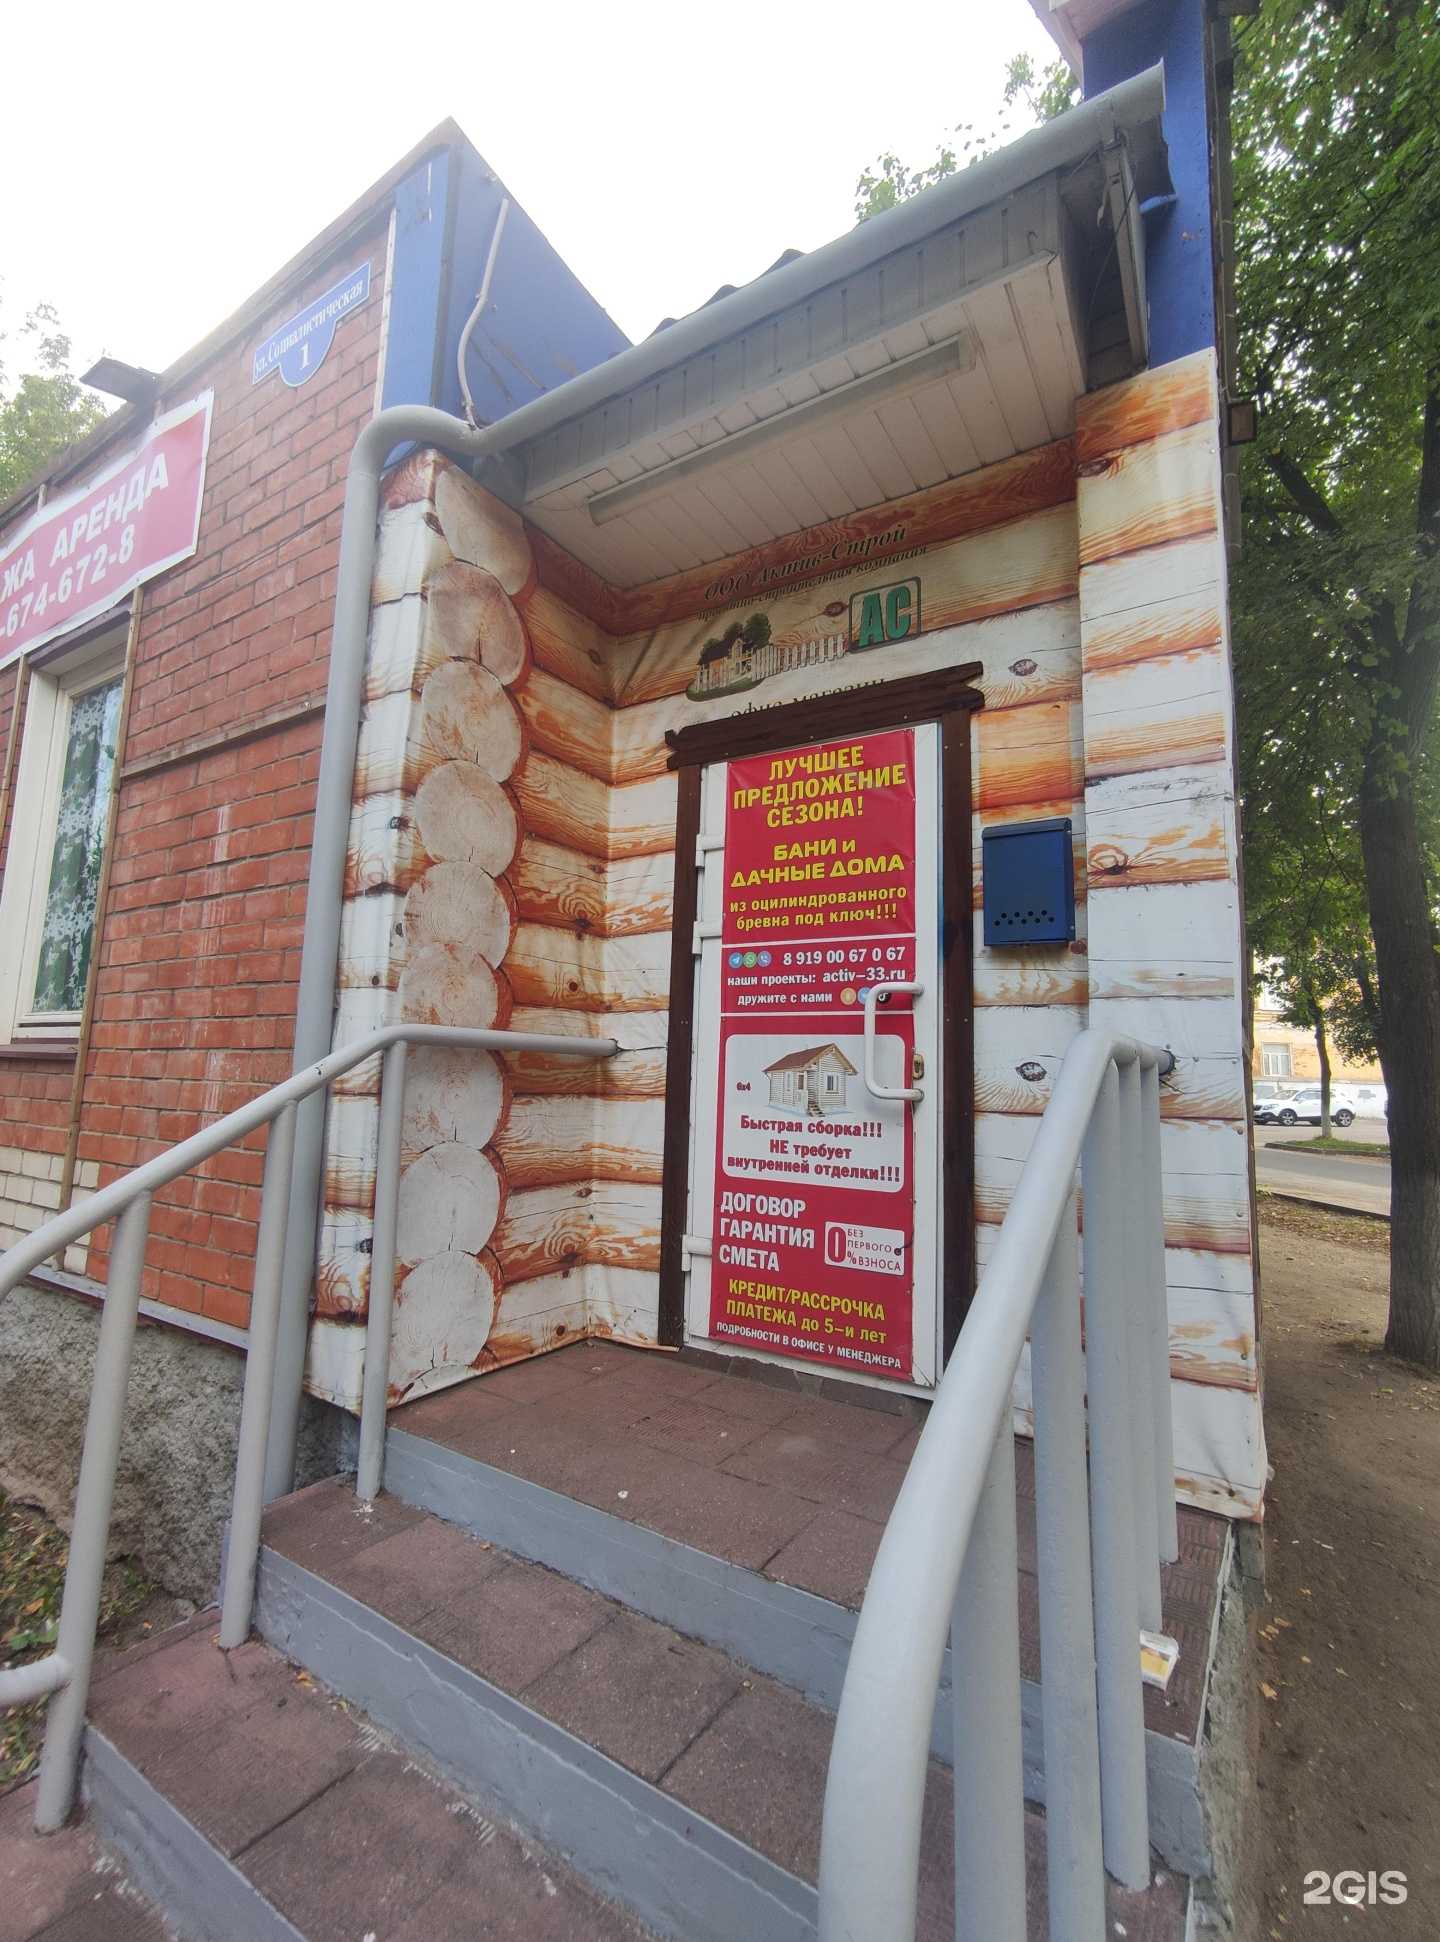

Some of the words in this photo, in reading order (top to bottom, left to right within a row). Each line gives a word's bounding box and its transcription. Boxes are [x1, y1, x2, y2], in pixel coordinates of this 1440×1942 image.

[268, 280, 363, 362] Социалистическая
[300, 342, 310, 371] 1
[50, 453, 168, 567] АРЕНДА
[769, 745, 864, 780] ЛУЧШЕЕ
[733, 763, 906, 809] ПРЕДЛОЖЕНИЕ
[767, 796, 863, 828] СЕЗОНА!
[773, 838, 836, 861] БАНИ
[842, 840, 856, 852] и
[730, 862, 825, 887] ДАЧНЫЕ
[830, 854, 904, 878] ДОМА
[730, 902, 746, 912] из
[751, 887, 907, 910] оцилиндрованного
[736, 916, 789, 931] бревна
[795, 912, 824, 926] под
[829, 903, 897, 923] ключ!!!
[783, 952, 792, 965] 8
[796, 951, 822, 965] 919
[826, 949, 844, 963] 00
[849, 948, 866, 962] 67
[872, 948, 881, 961] 0
[886, 946, 905, 961] 67
[727, 975, 757, 986] наши
[761, 974, 816, 987] проекты:
[823, 967, 906, 983] activ-33.ru
[737, 993, 786, 1006] дружите
[790, 994, 797, 1003] с
[801, 992, 832, 1003] нами
[740, 1115, 802, 1133] Быстрая
[807, 1120, 882, 1138] сборка!!!
[769, 1139, 788, 1155] НЕ
[793, 1143, 852, 1160] требует
[727, 1156, 809, 1174] внутренней
[814, 1163, 900, 1182] отделки!!!
[720, 1191, 806, 1218] ДОГОВОР
[719, 1217, 815, 1248] ГАРАНТИЯ
[847, 1228, 863, 1237] БЕЗ
[847, 1240, 891, 1253] ПЕРВОГО
[719, 1244, 780, 1272] СМЕТА
[858, 1256, 901, 1271] ВЗНОСА
[729, 1278, 885, 1320] КРЕДИТ/РАССРОЧКА
[726, 1300, 797, 1327] ПЛАТЕЖА
[801, 1317, 819, 1332] до
[860, 1330, 887, 1344] лет
[717, 1321, 780, 1343] ПОДРОБНОСТИ
[782, 1336, 789, 1345] В
[791, 1338, 825, 1353] ОФИСЕ
[828, 1344, 834, 1353] У
[837, 1346, 901, 1369] МЕНЕДЖЕРА
